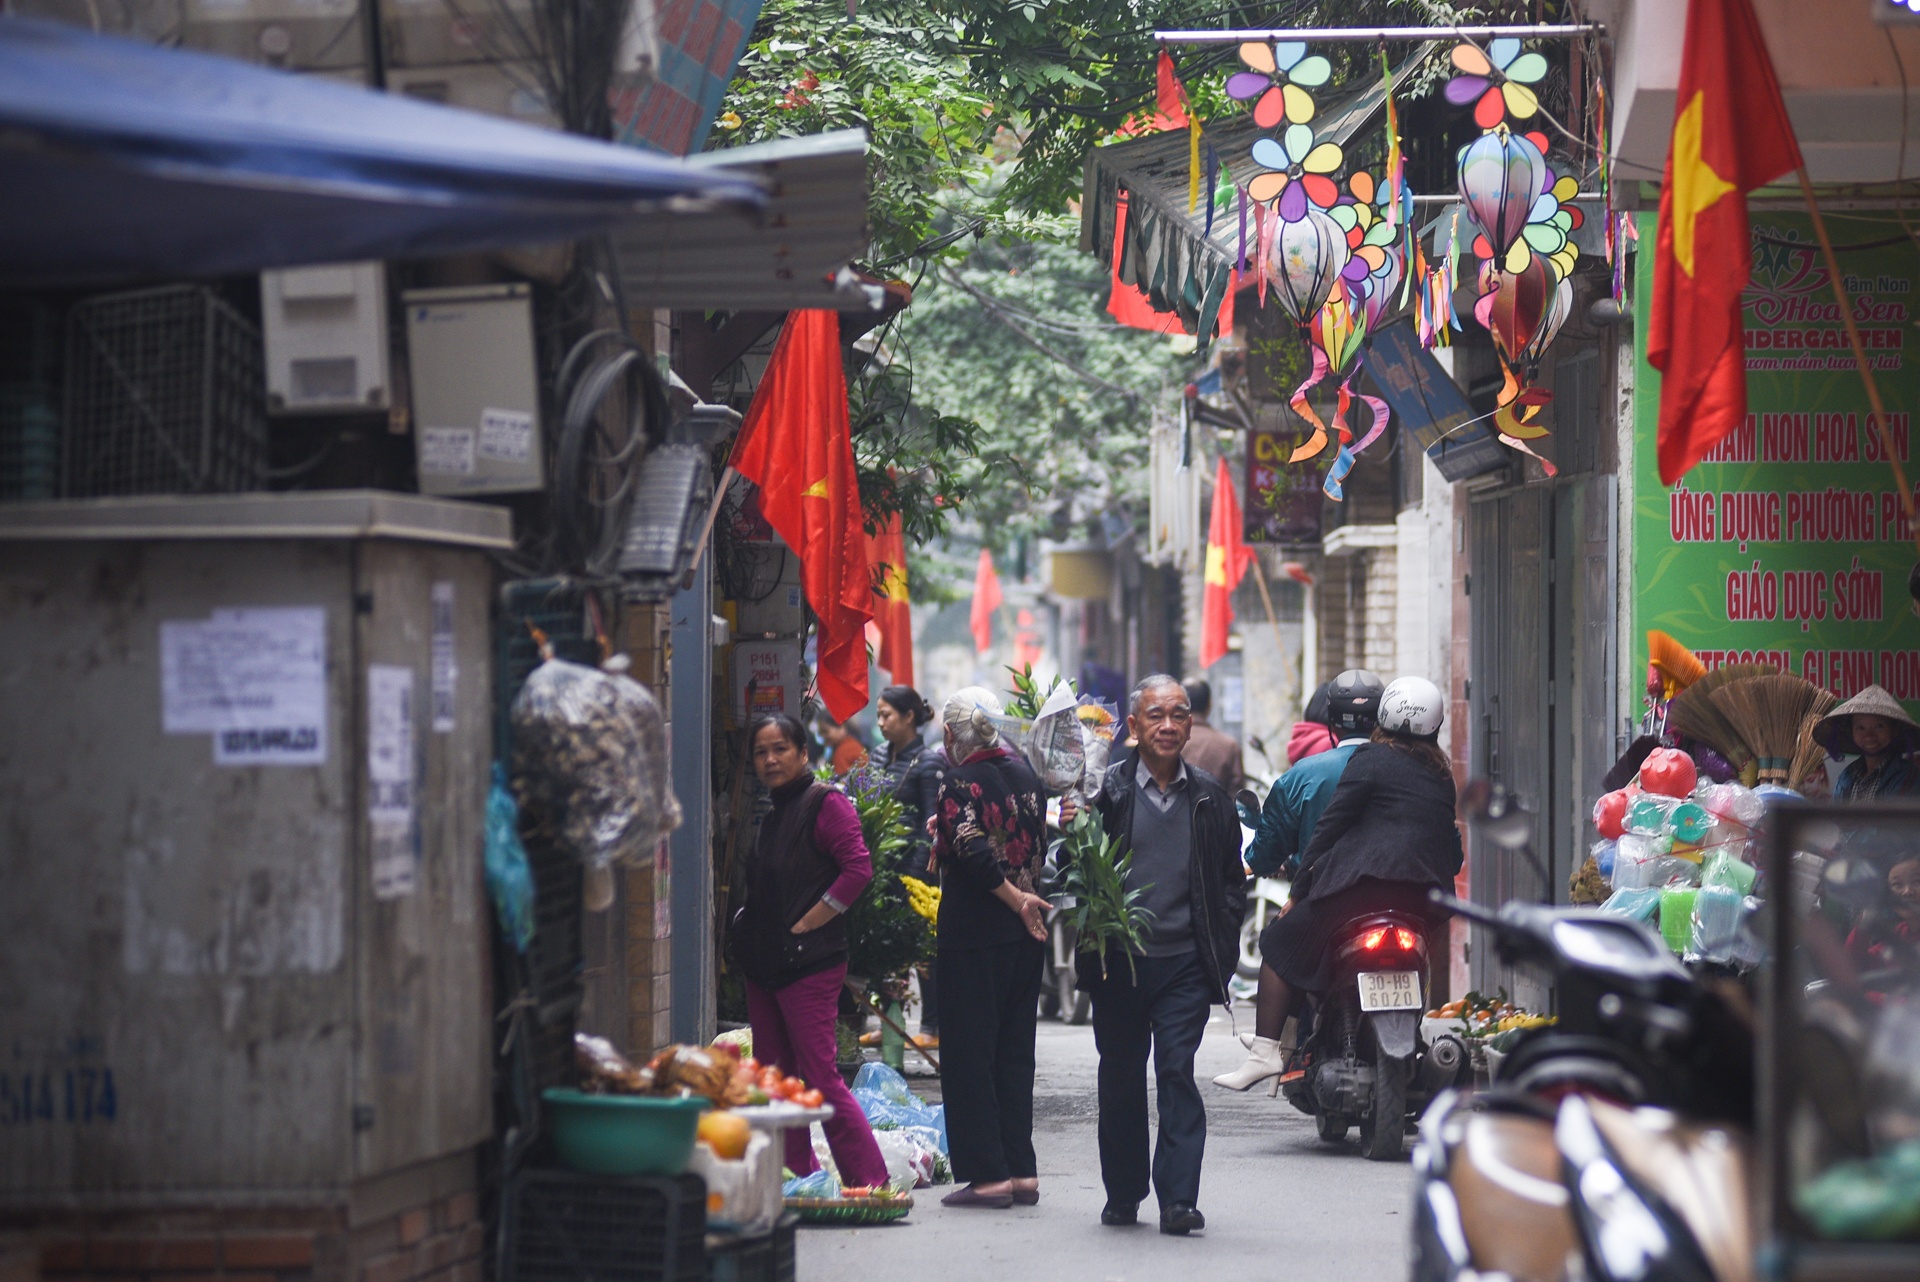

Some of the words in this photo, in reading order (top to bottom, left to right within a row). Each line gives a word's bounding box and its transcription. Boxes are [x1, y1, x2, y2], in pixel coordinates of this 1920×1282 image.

[1878, 275, 1909, 293] Non
[1784, 295, 1843, 322] Hoa
[1852, 295, 1909, 323] Sen
[1762, 412, 1810, 463] NON
[1814, 412, 1860, 463] HOA
[1863, 412, 1909, 463] SEN
[1721, 491, 1781, 554] DỤNG
[1786, 487, 1875, 542] PHƯƠNG
[1726, 560, 1778, 622] GIÁO
[1783, 570, 1827, 632] DỤC
[1833, 556, 1883, 622] SỚM
[1369, 991, 1412, 1007] 6020
